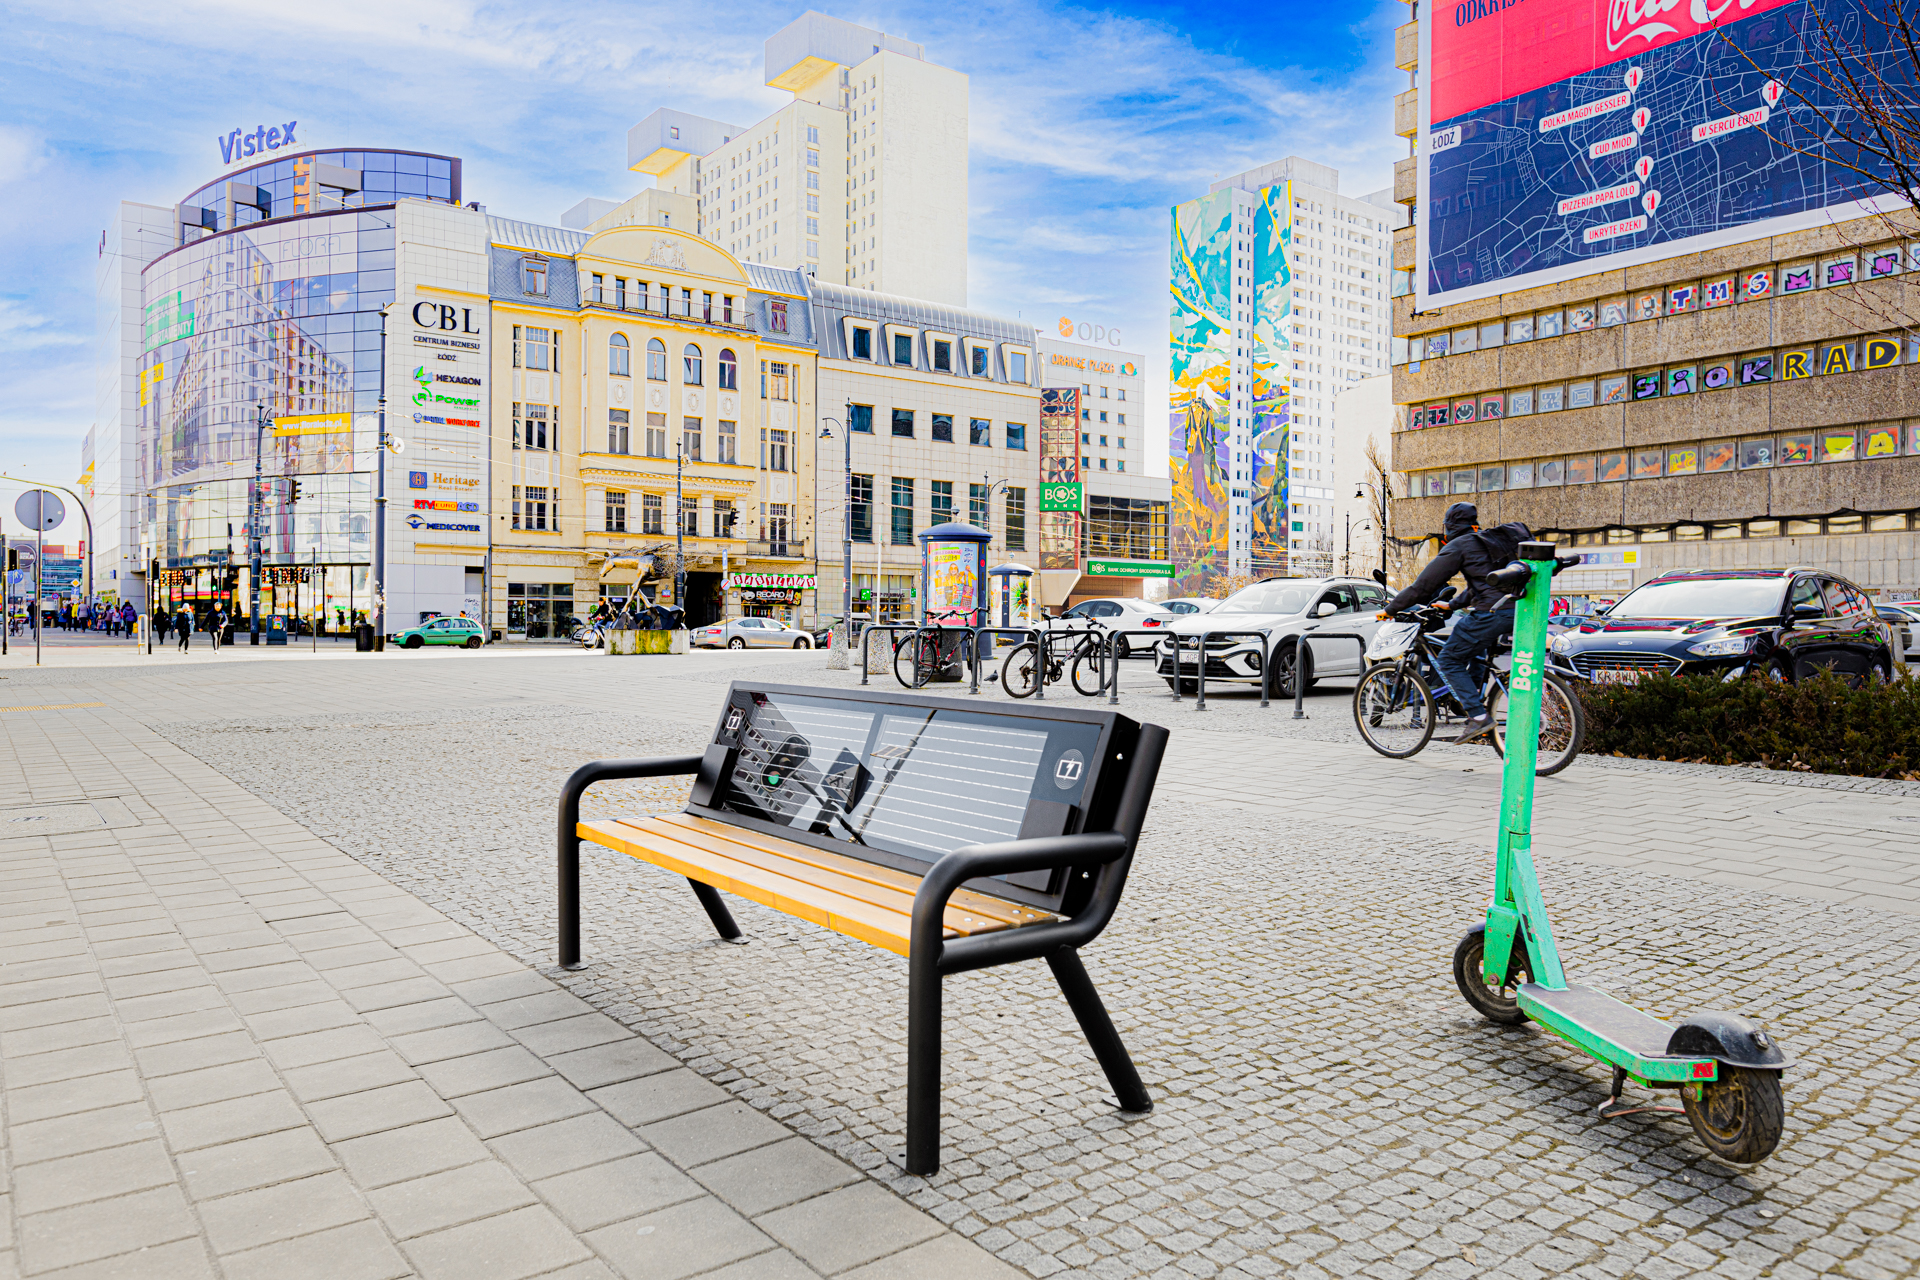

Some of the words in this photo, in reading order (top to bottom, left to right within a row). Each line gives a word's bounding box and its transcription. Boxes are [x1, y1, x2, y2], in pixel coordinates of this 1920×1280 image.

[1456, 0, 1517, 27] ODKR
[1543, 115, 1566, 130] POLKA
[1568, 107, 1593, 122] MAGDY
[1594, 95, 1627, 113] GESSLER
[1698, 127, 1706, 137] W
[1708, 119, 1735, 135] SERCU
[1737, 111, 1762, 127] ŁODZI
[218, 120, 297, 165] Vistex
[1432, 127, 1455, 149] ŁÓDŹ
[1594, 143, 1610, 155] CUD
[1611, 135, 1632, 150] MIÓD
[1562, 198, 1594, 212] PIZZERIA
[1595, 192, 1614, 203] PAPA
[1616, 185, 1634, 198] LOLO
[1589, 224, 1618, 240] UKRYTE
[1620, 219, 1642, 233] RZEKI
[282, 235, 341, 260] FLORA
[412, 301, 480, 335] CBL
[413, 335, 449, 345] CENTRUM
[450, 340, 481, 350] BIZNESU
[1077, 322, 1121, 347] OPG
[1051, 353, 1086, 369] ORANGE
[1089, 359, 1116, 374] PLAZA
[436, 373, 481, 386] HEXAGON
[433, 472, 480, 487] Heritage
[426, 522, 481, 532] MEDICOVER
[734, 575, 815, 588] BABYLAND
[1512, 650, 1536, 691] Bolt
